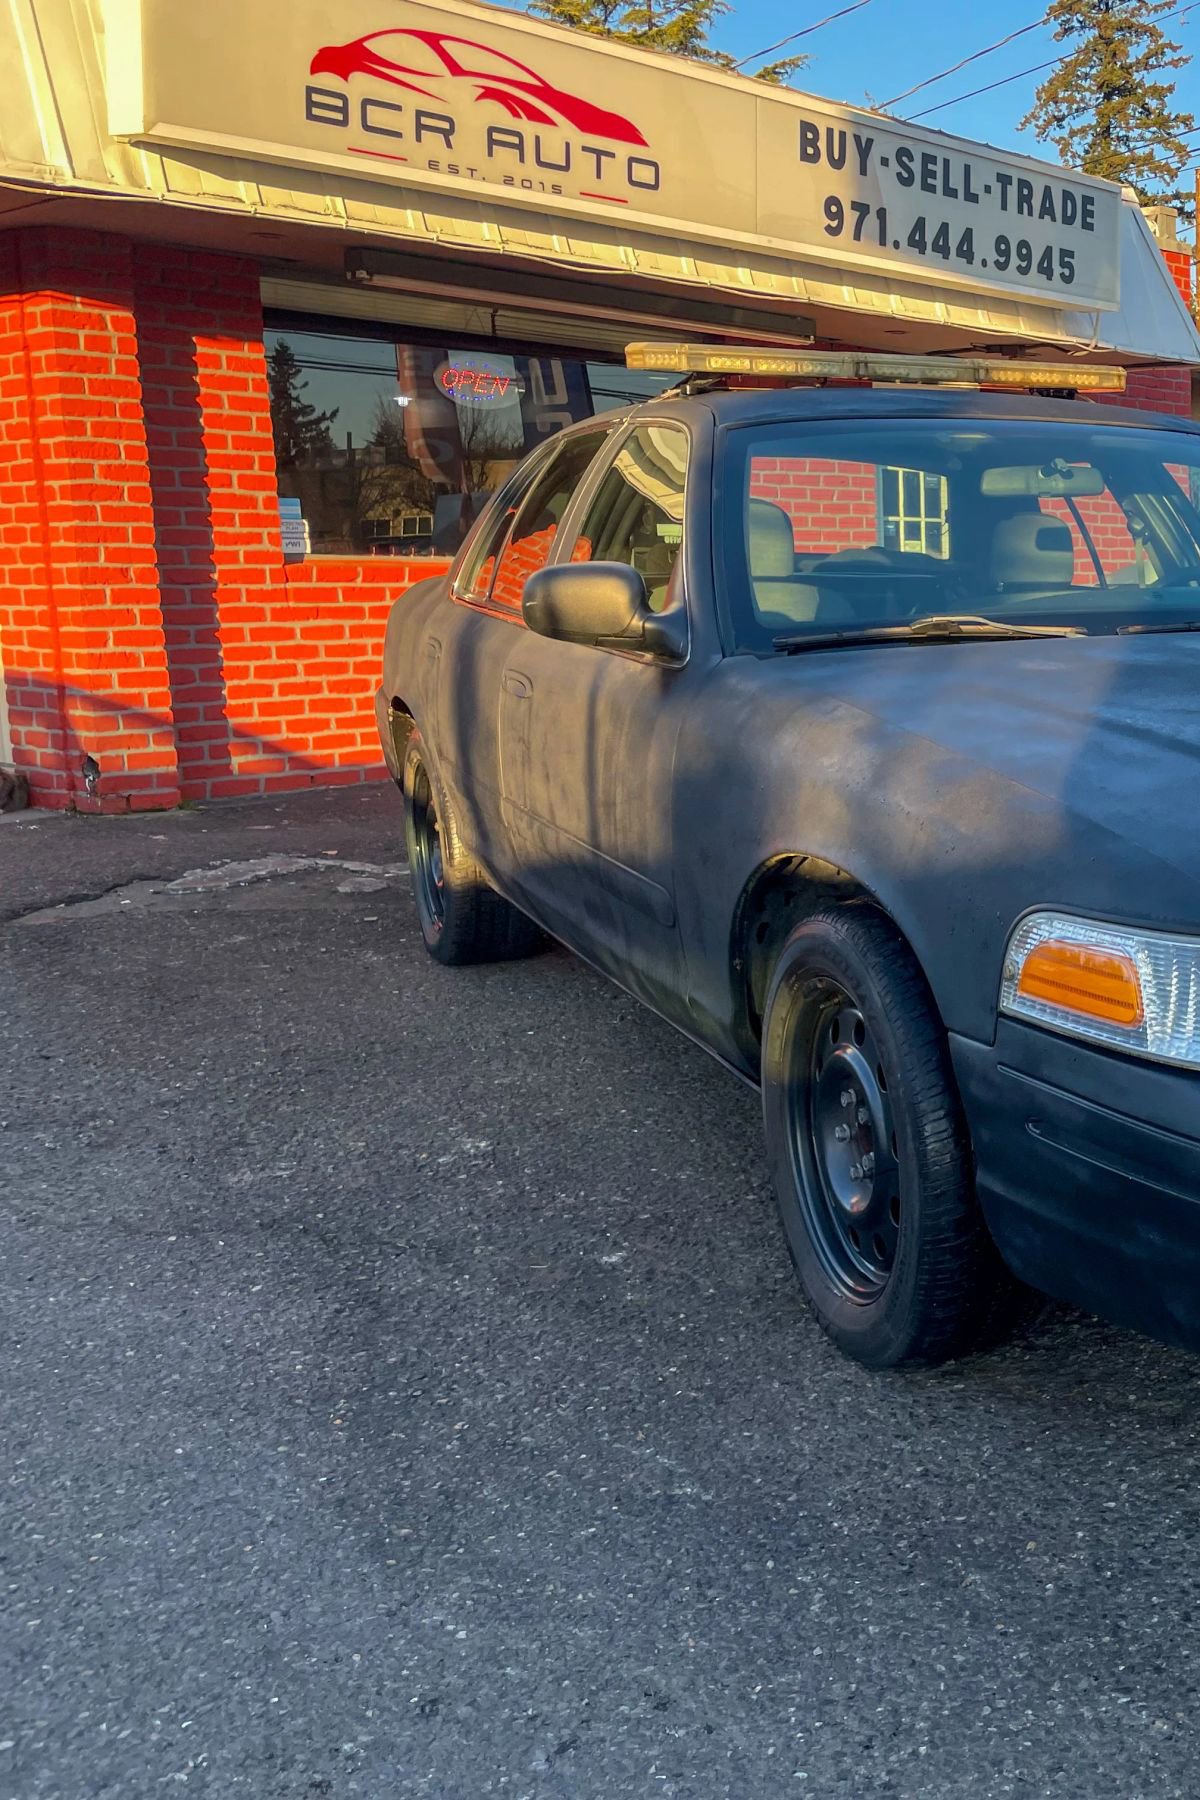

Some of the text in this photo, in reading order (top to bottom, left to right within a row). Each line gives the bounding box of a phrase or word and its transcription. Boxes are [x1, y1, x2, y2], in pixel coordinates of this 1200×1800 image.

[305, 85, 661, 192] BCR AUTO
[428, 160, 563, 195] EST. 2015
[823, 195, 1076, 285] 971.444.9945
[441, 368, 510, 397] OPEN
